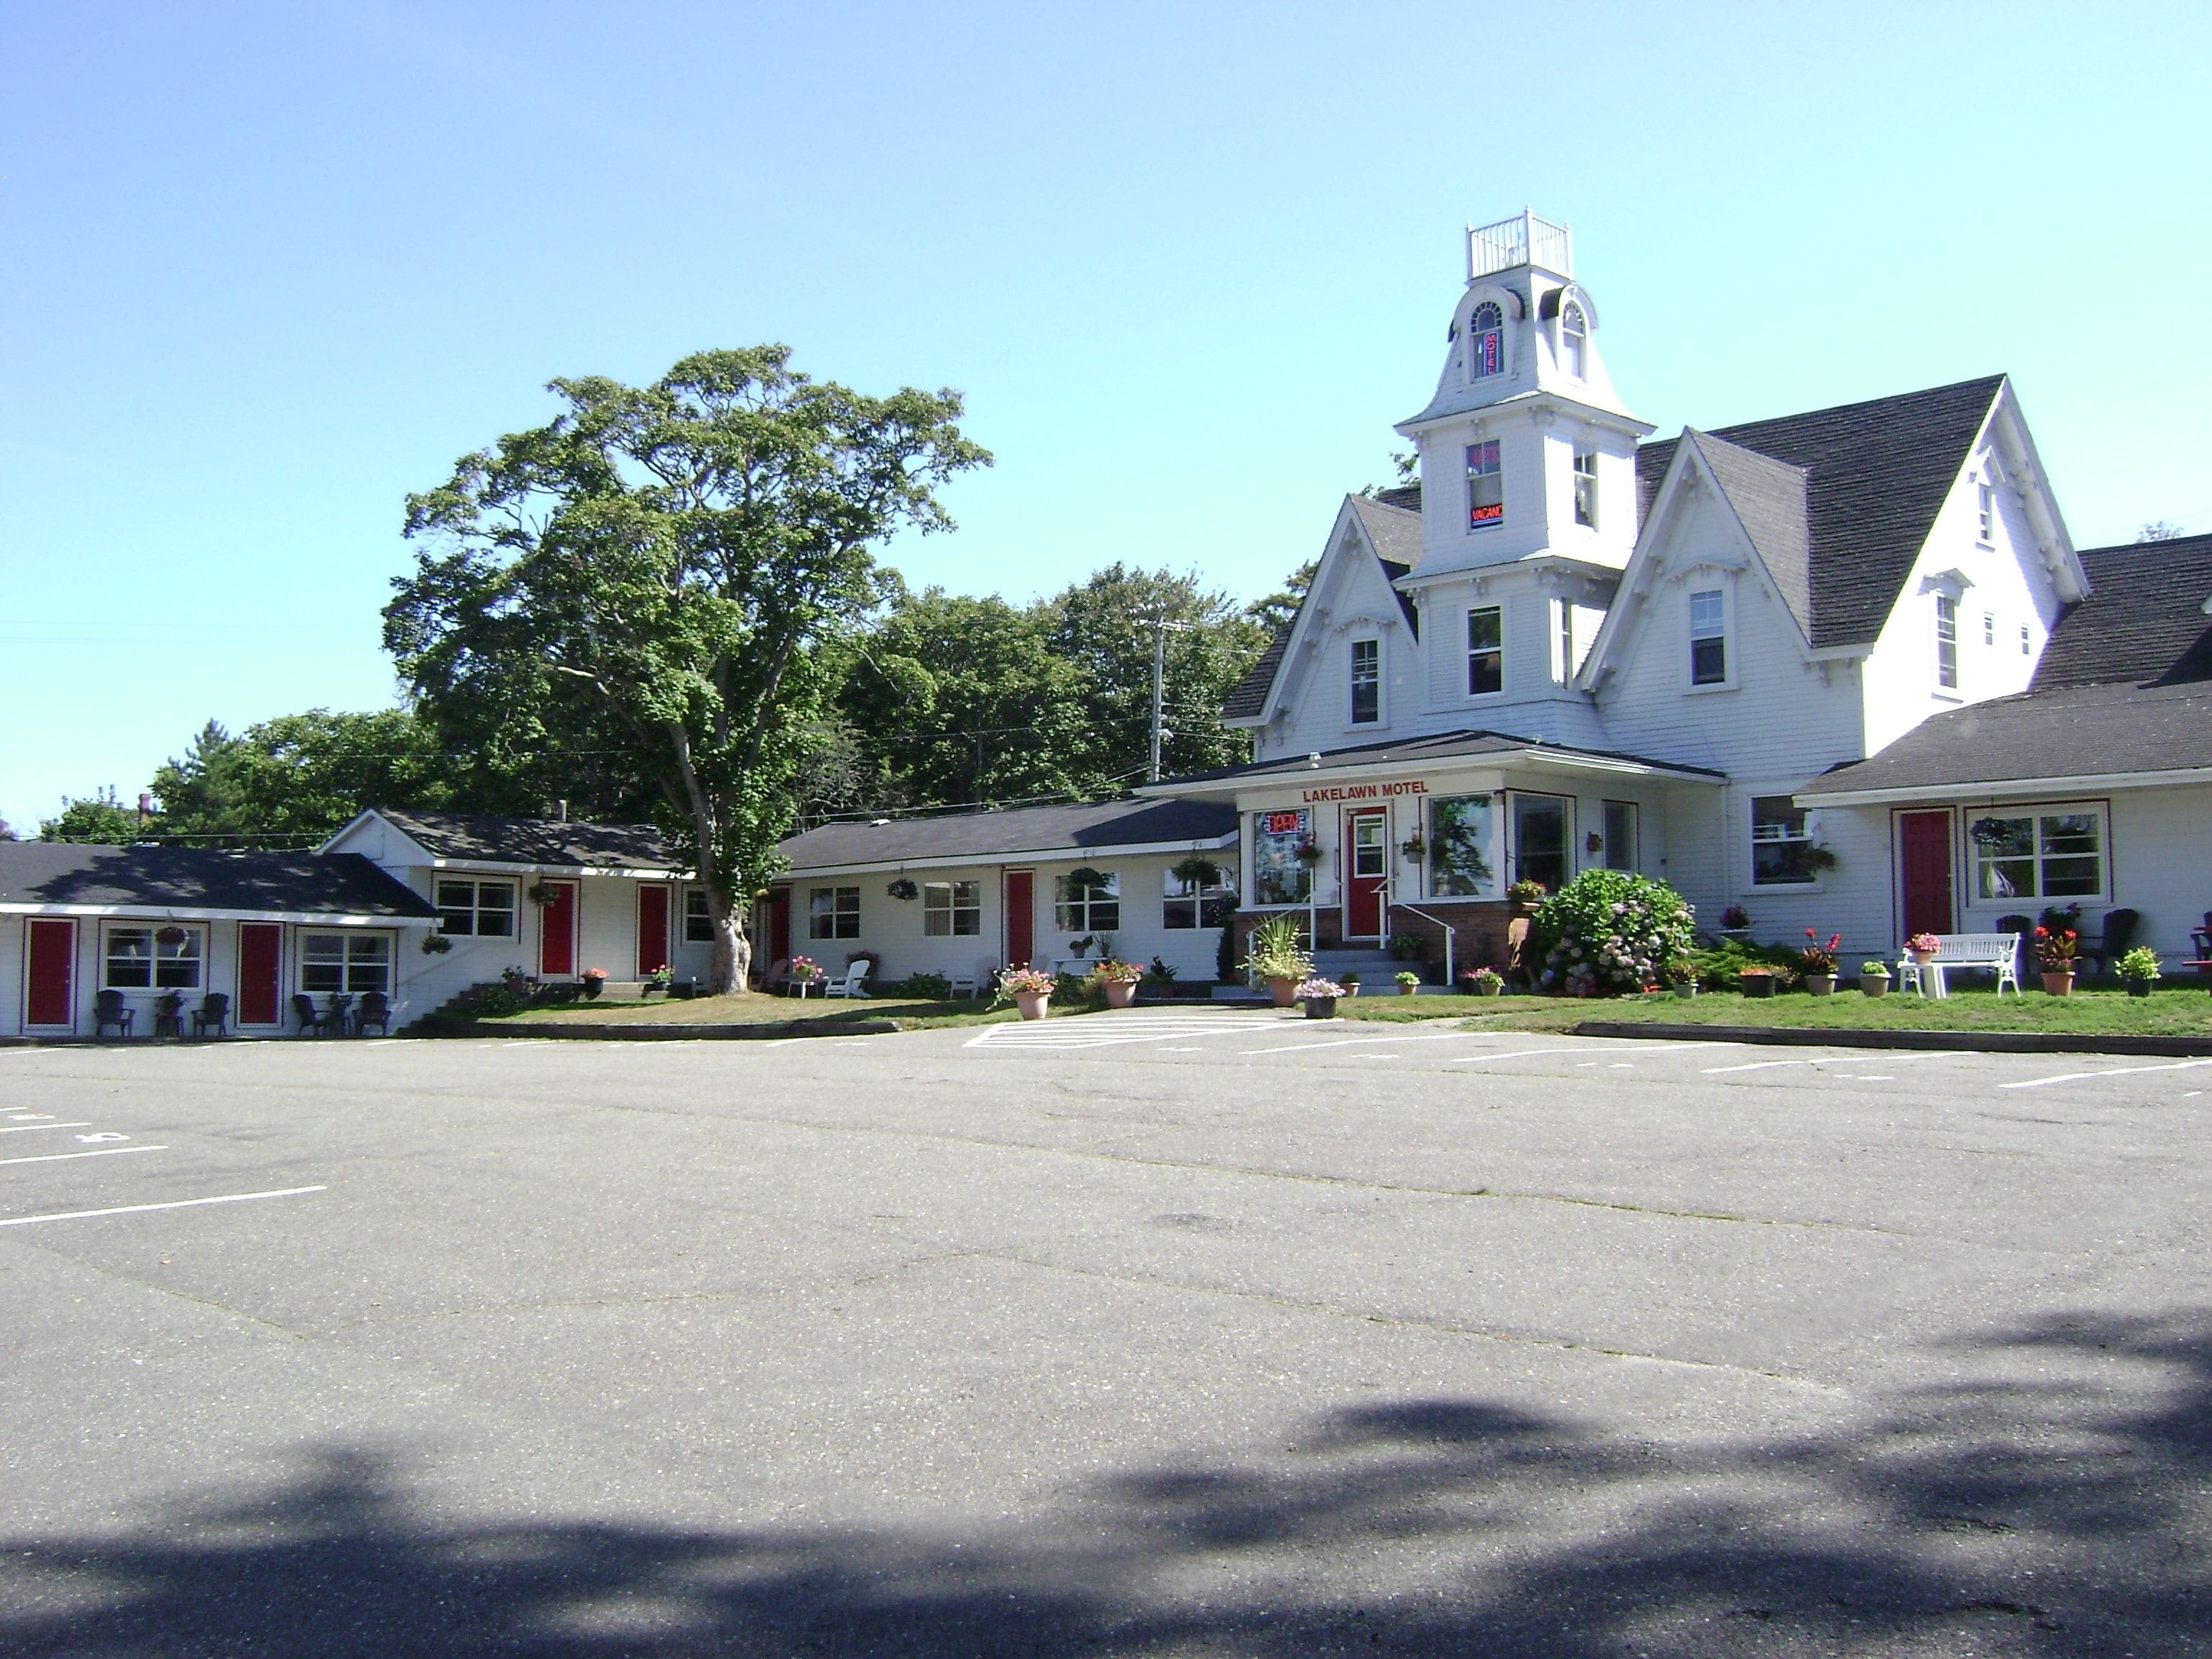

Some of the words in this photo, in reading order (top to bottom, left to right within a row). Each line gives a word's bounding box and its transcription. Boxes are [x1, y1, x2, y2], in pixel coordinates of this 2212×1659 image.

[1485, 334, 1497, 375] MOTEL
[1473, 505, 1503, 520] VACANC
[1303, 785, 1377, 803] LAKELAWN
[1382, 781, 1429, 796] MOTEL
[1268, 814, 1300, 833] OPEN
